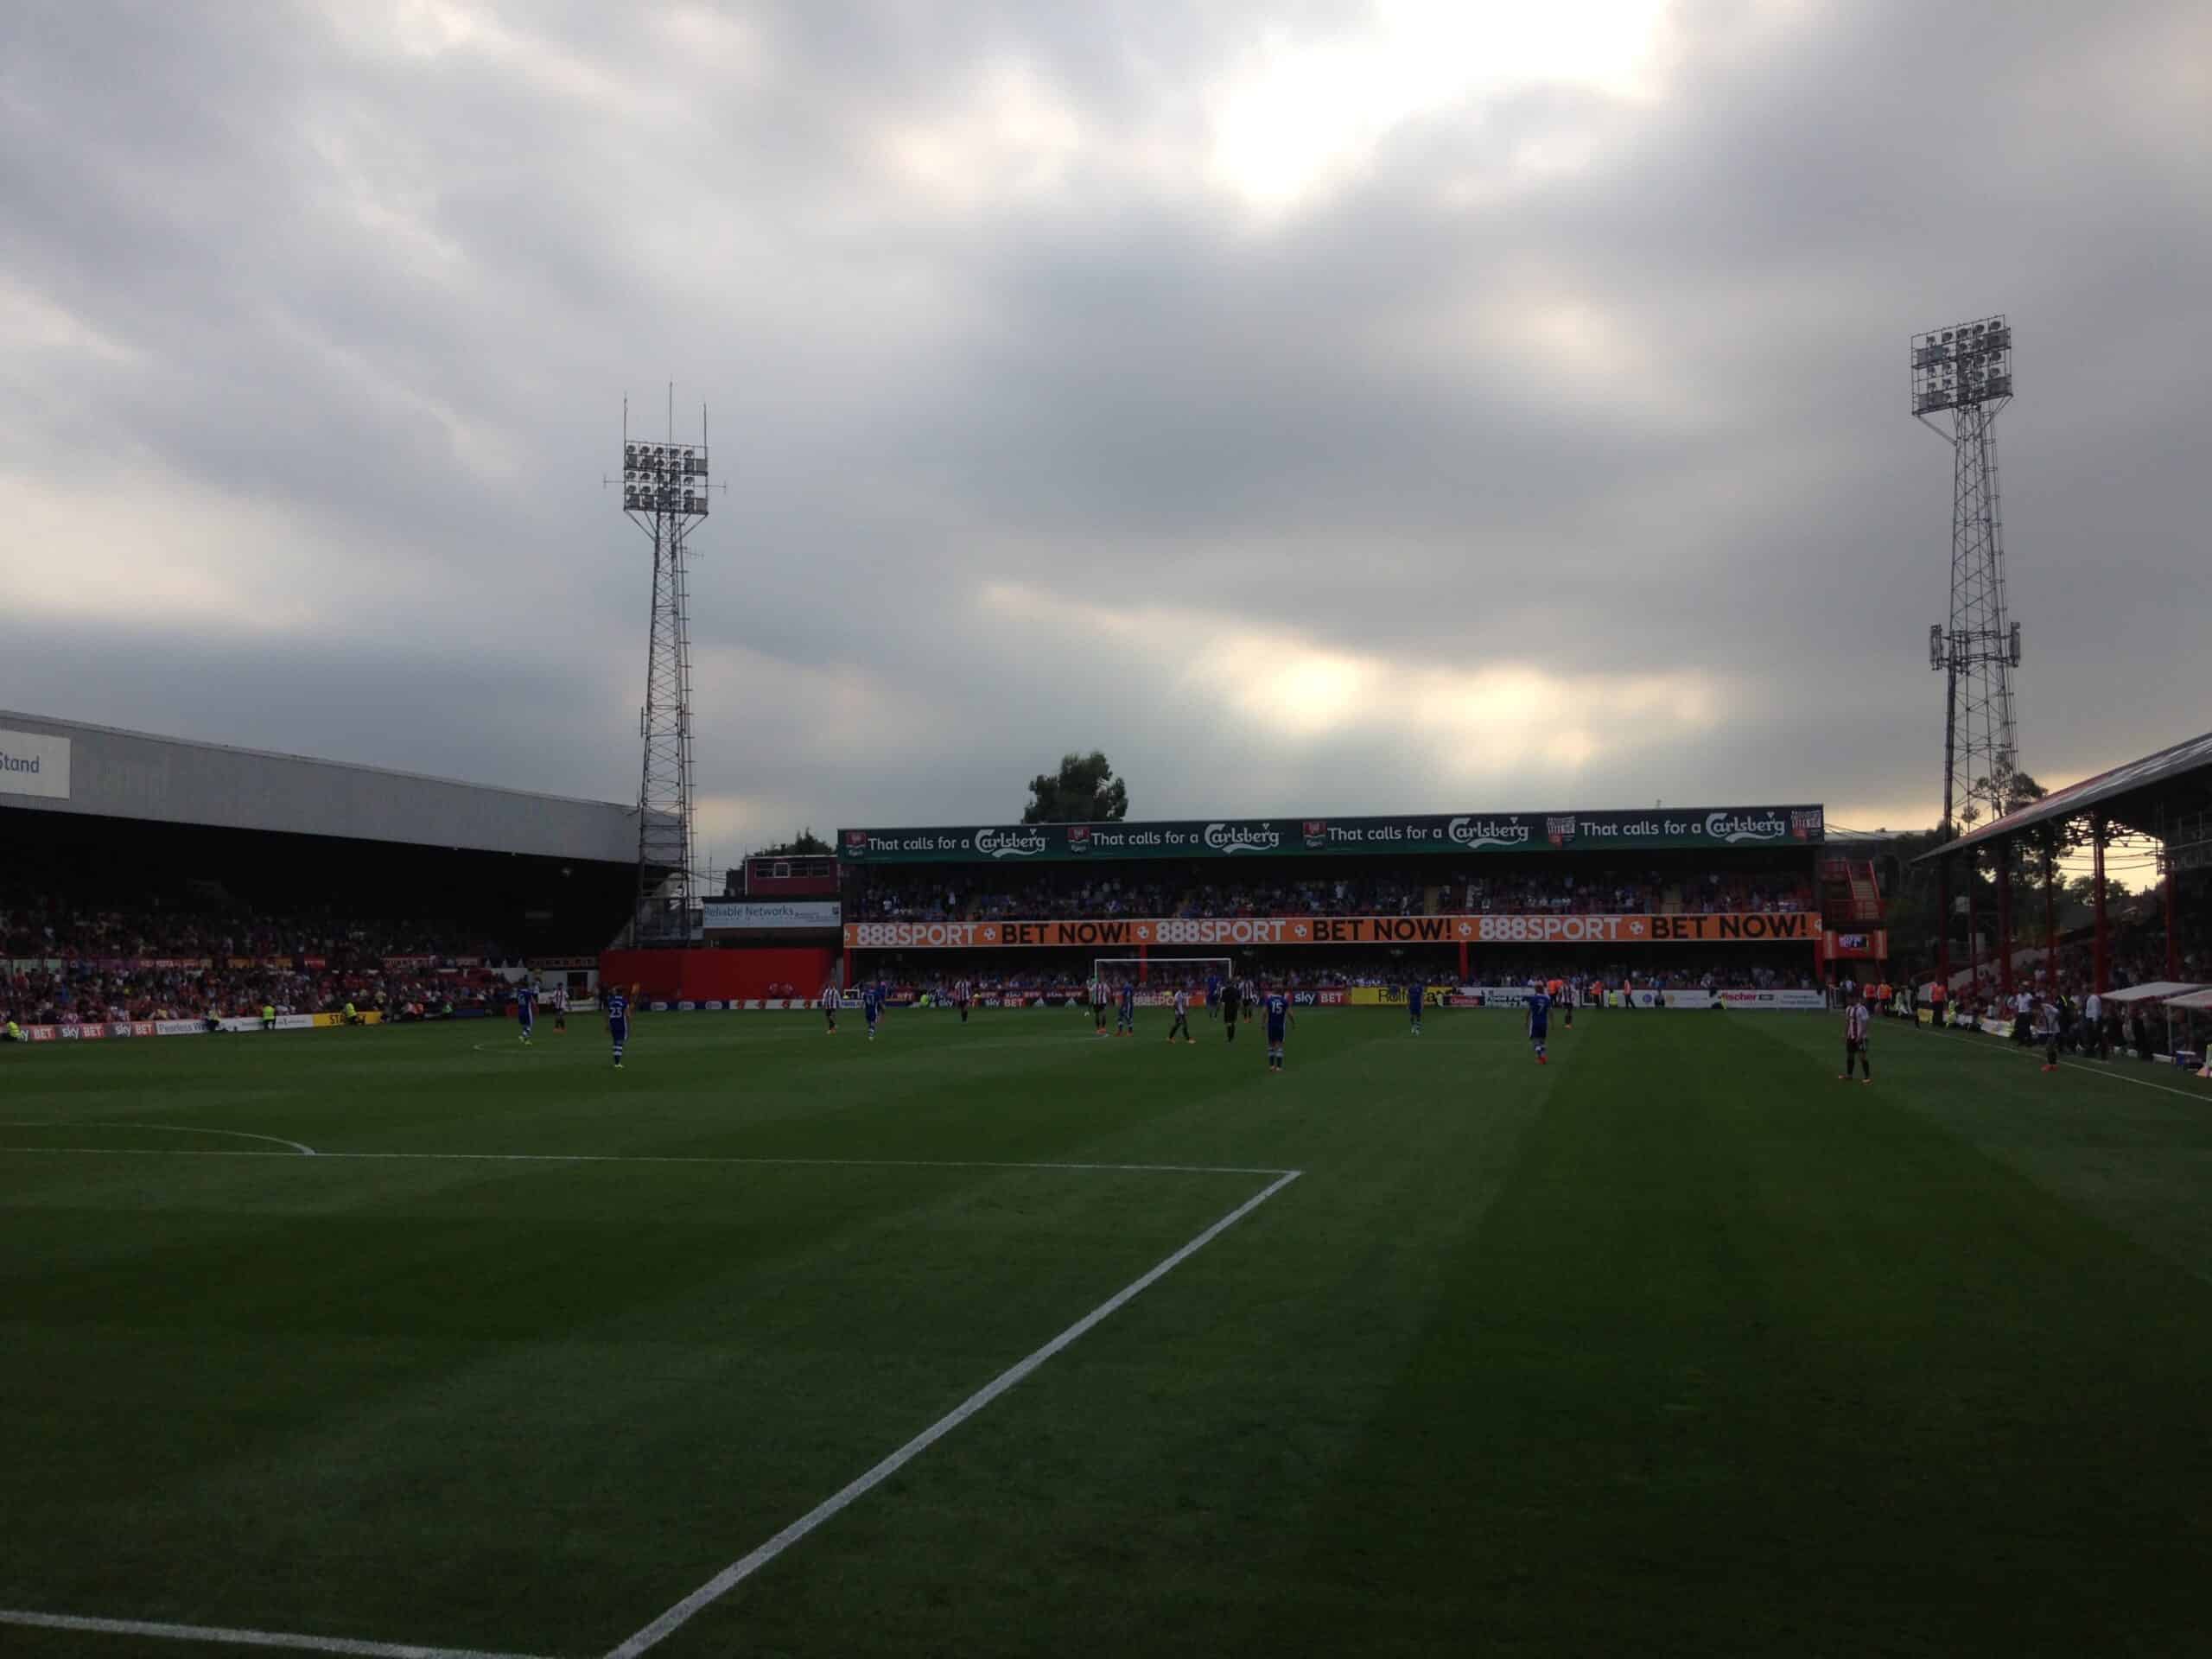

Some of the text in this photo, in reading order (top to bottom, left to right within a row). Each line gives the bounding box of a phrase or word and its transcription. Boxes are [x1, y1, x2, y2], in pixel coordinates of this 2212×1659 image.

[1091, 823, 1280, 854] That calls for a Carlsberg
[1327, 817, 1529, 849] That calls for a Carlsberg
[1580, 811, 1785, 843] That calls for a Carlsberg
[868, 829, 1046, 857] That calls for a Carlsberg
[746, 905, 795, 917] Networks
[857, 914, 1808, 945] 888SPORT BET NOW! 888SPORT BET NOW! 888SPORT BET NOW!
[1294, 991, 1343, 1006] sky BET
[82, 1025, 104, 1037] BET
